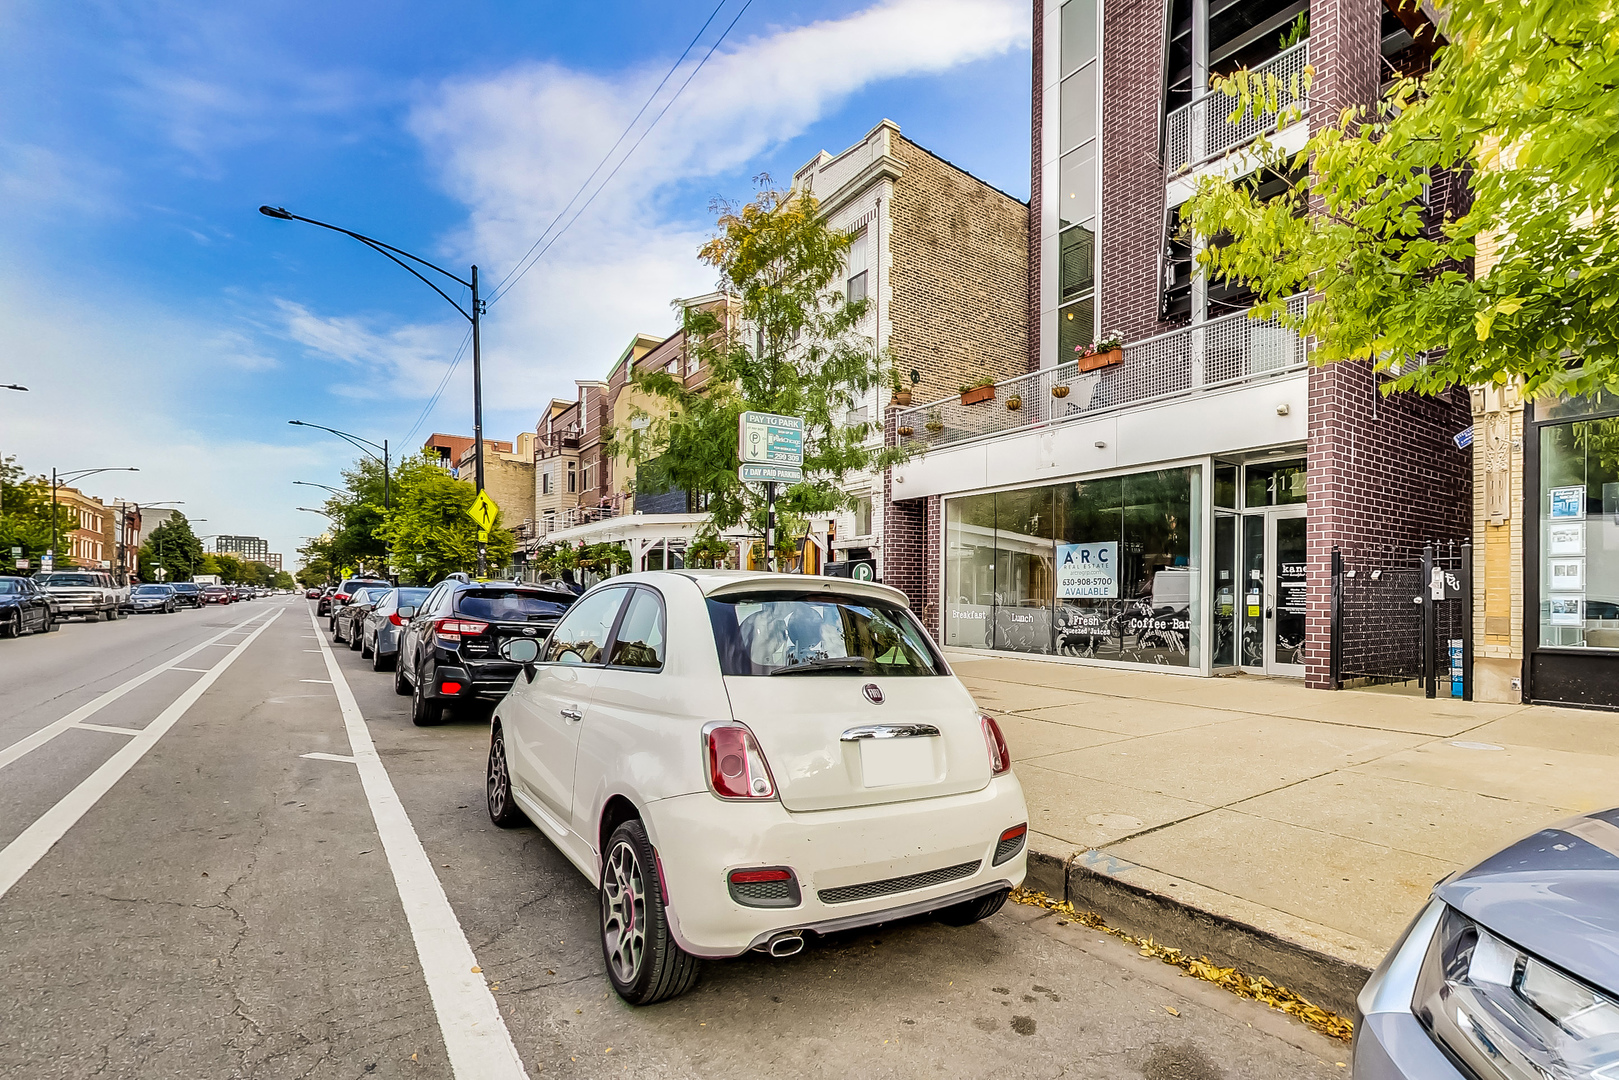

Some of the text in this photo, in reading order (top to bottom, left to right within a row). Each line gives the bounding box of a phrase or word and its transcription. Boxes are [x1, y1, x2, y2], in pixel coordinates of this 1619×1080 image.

[749, 415, 799, 428] PAY TO PARK
[762, 469, 776, 477] PAID
[777, 470, 801, 479] PARKING
[1062, 577, 1112, 586] 630-908-5700
[1064, 587, 1109, 596] AVAILABLE
[952, 609, 986, 620] Breakfast
[1011, 613, 1034, 623] Lunch
[1073, 615, 1099, 626] Fresh
[1131, 618, 1192, 630] Coffee Bar
[1062, 626, 1111, 635] Squeezed Juices
